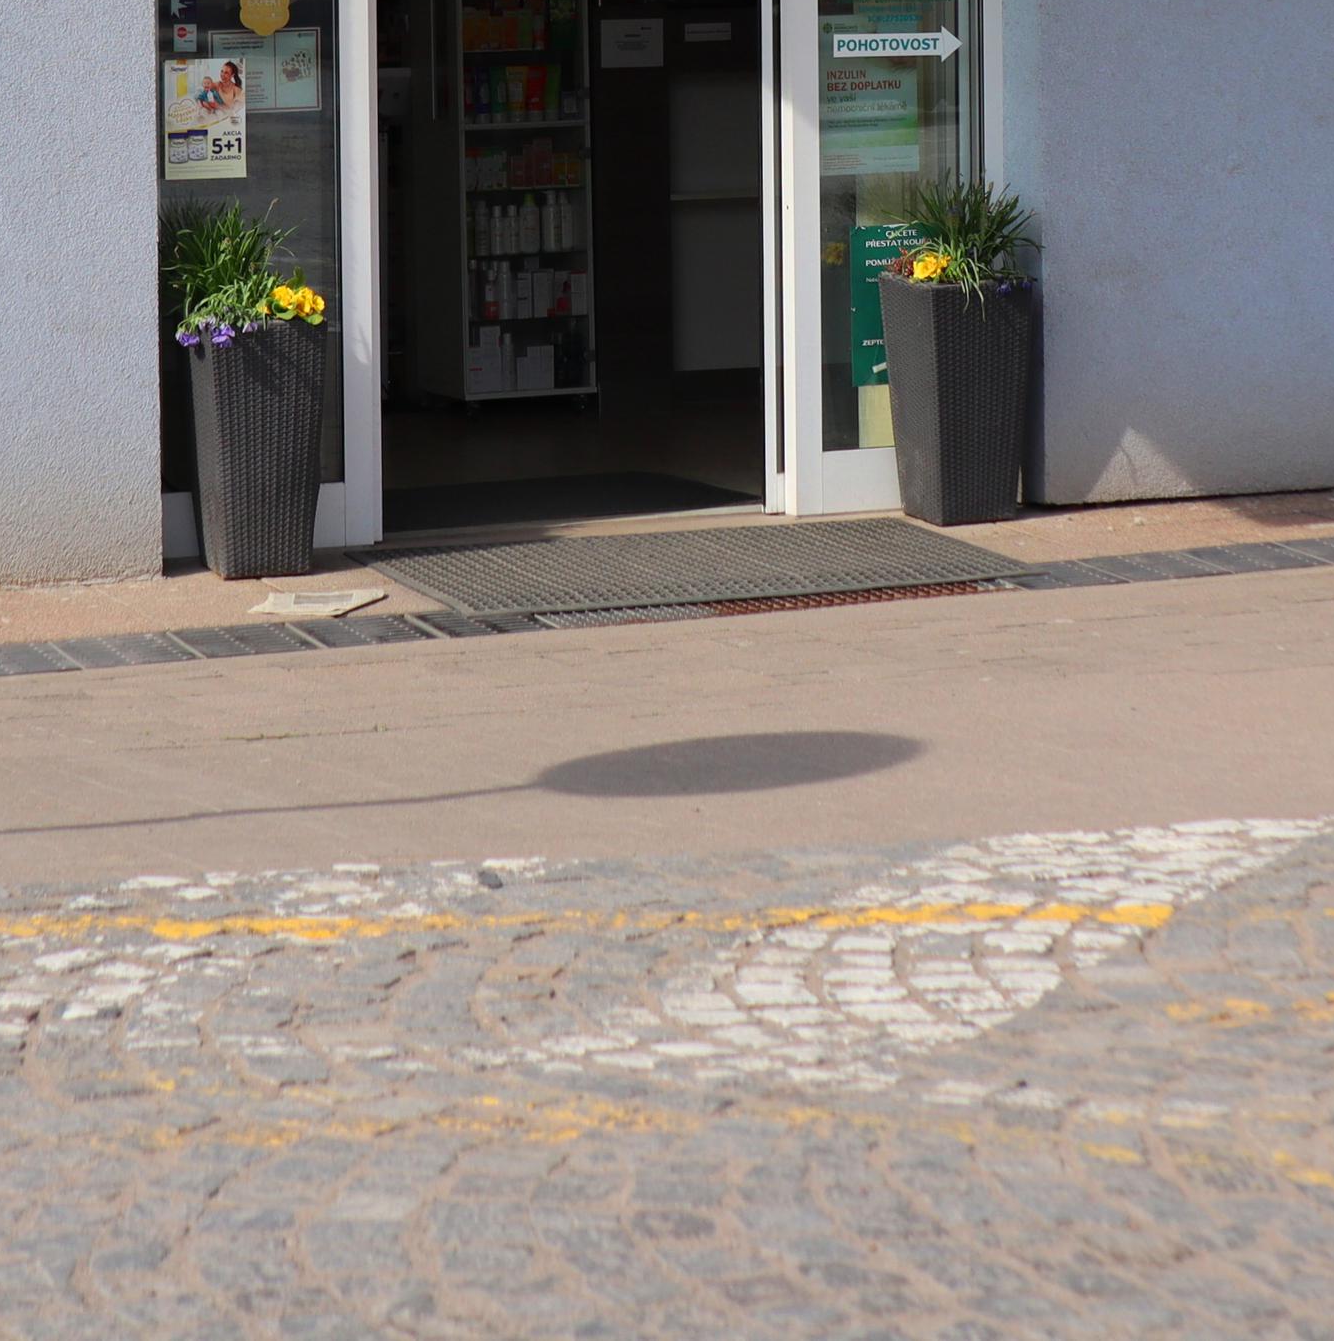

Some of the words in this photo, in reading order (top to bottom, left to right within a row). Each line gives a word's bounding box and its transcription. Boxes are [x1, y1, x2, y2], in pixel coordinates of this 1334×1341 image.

[837, 38, 940, 52] POHOTOVOST
[827, 70, 866, 80] INZULIN
[827, 83, 847, 92] BEZ
[850, 80, 902, 91] DOPLATKU
[211, 137, 242, 154] 5+1
[865, 238, 903, 248] PŘESTAT
